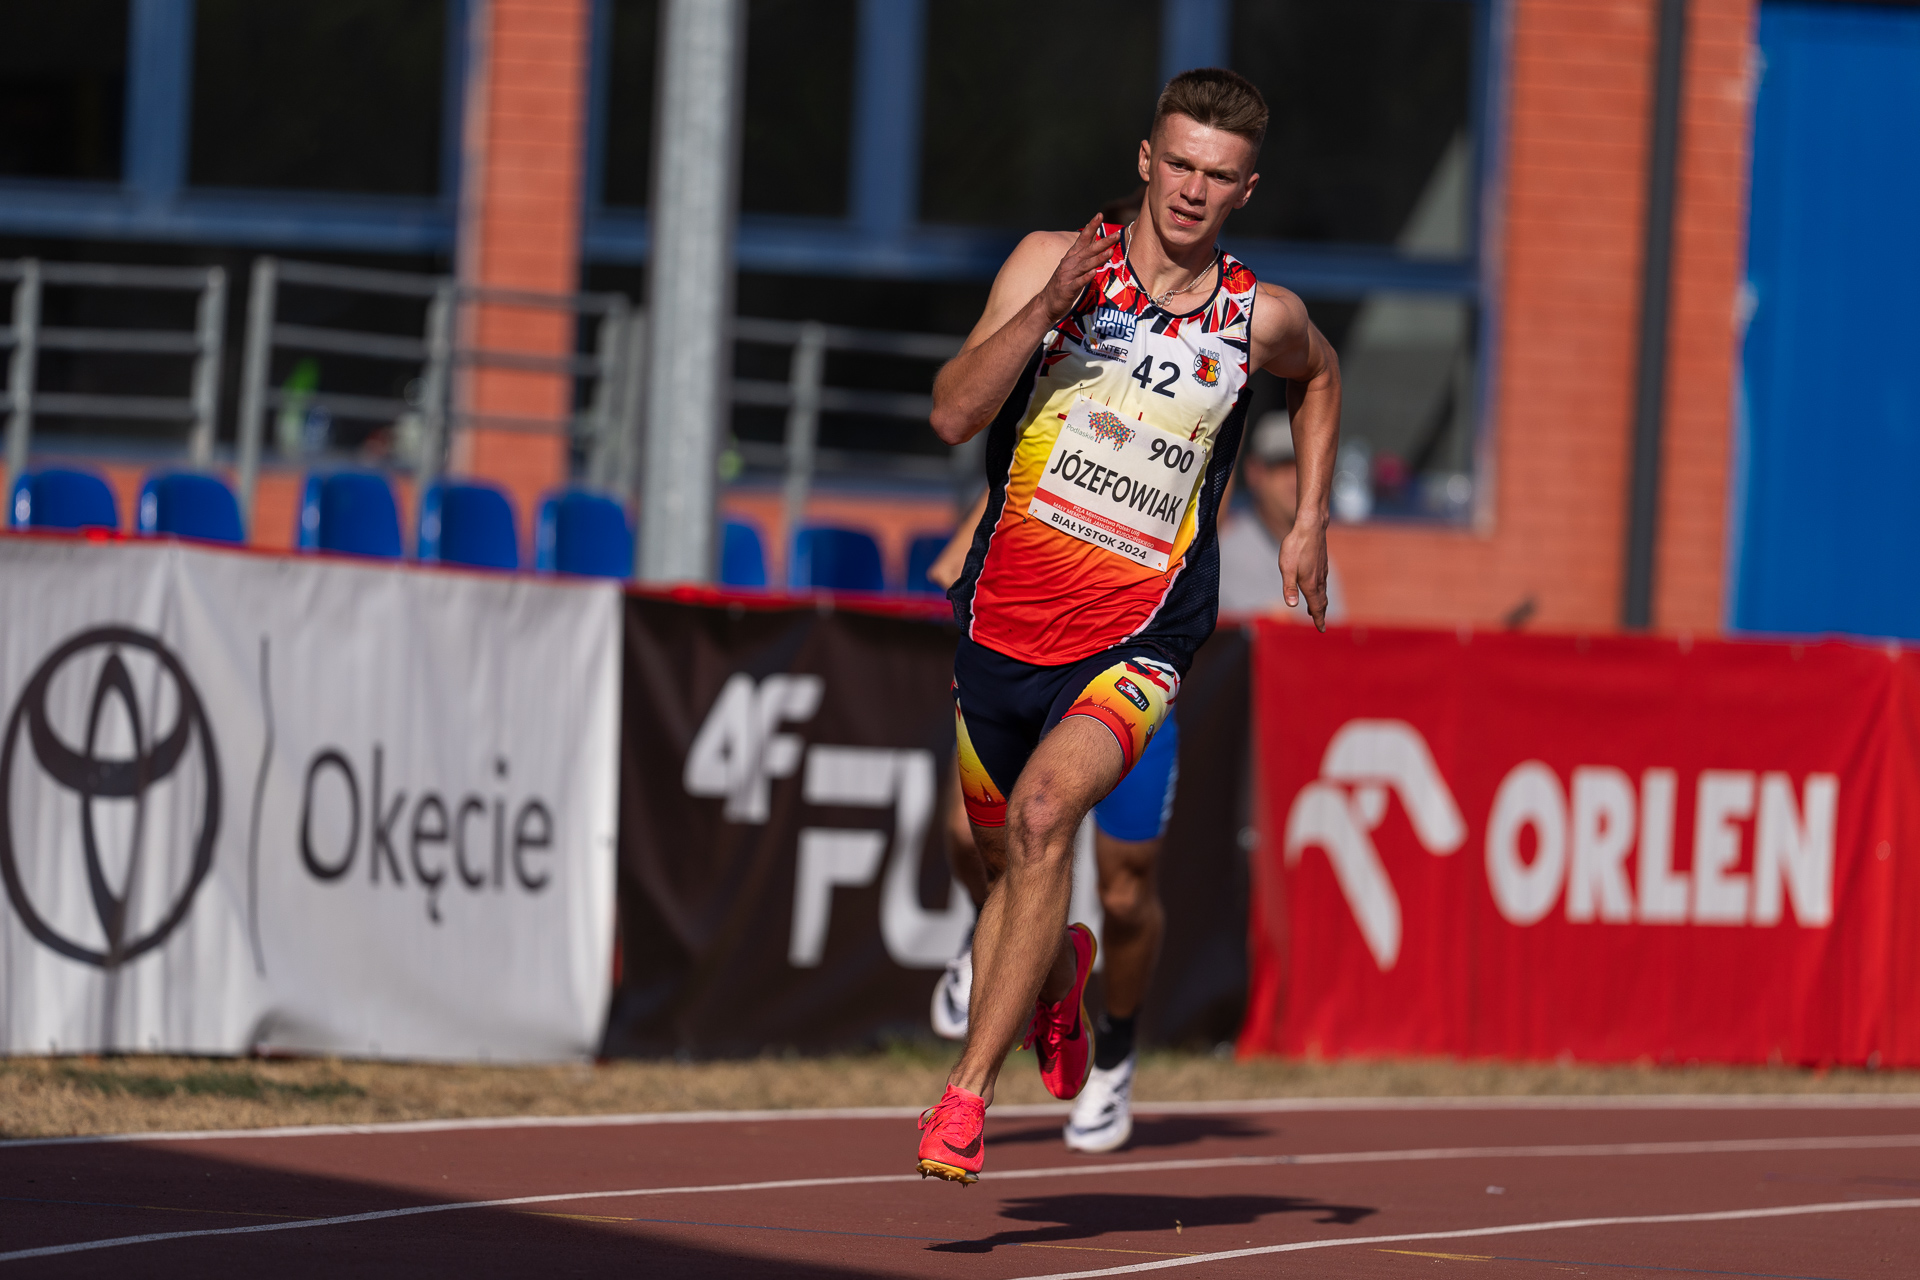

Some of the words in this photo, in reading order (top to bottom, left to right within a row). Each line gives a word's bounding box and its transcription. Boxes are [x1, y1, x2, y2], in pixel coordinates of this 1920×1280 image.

[1095, 320, 1135, 341] HAUS
[1098, 307, 1138, 328] WINK
[1132, 354, 1180, 398] 42
[1066, 423, 1095, 441] Podlaskie
[1147, 438, 1195, 474] 900
[1050, 449, 1183, 525] JÓZEFOWIAK
[1051, 512, 1117, 548] BIAŁYSTOK
[1117, 541, 1148, 560] 2024
[682, 672, 824, 824] 4F
[298, 742, 557, 925] Okęcie
[1485, 759, 1840, 928] ORLEN
